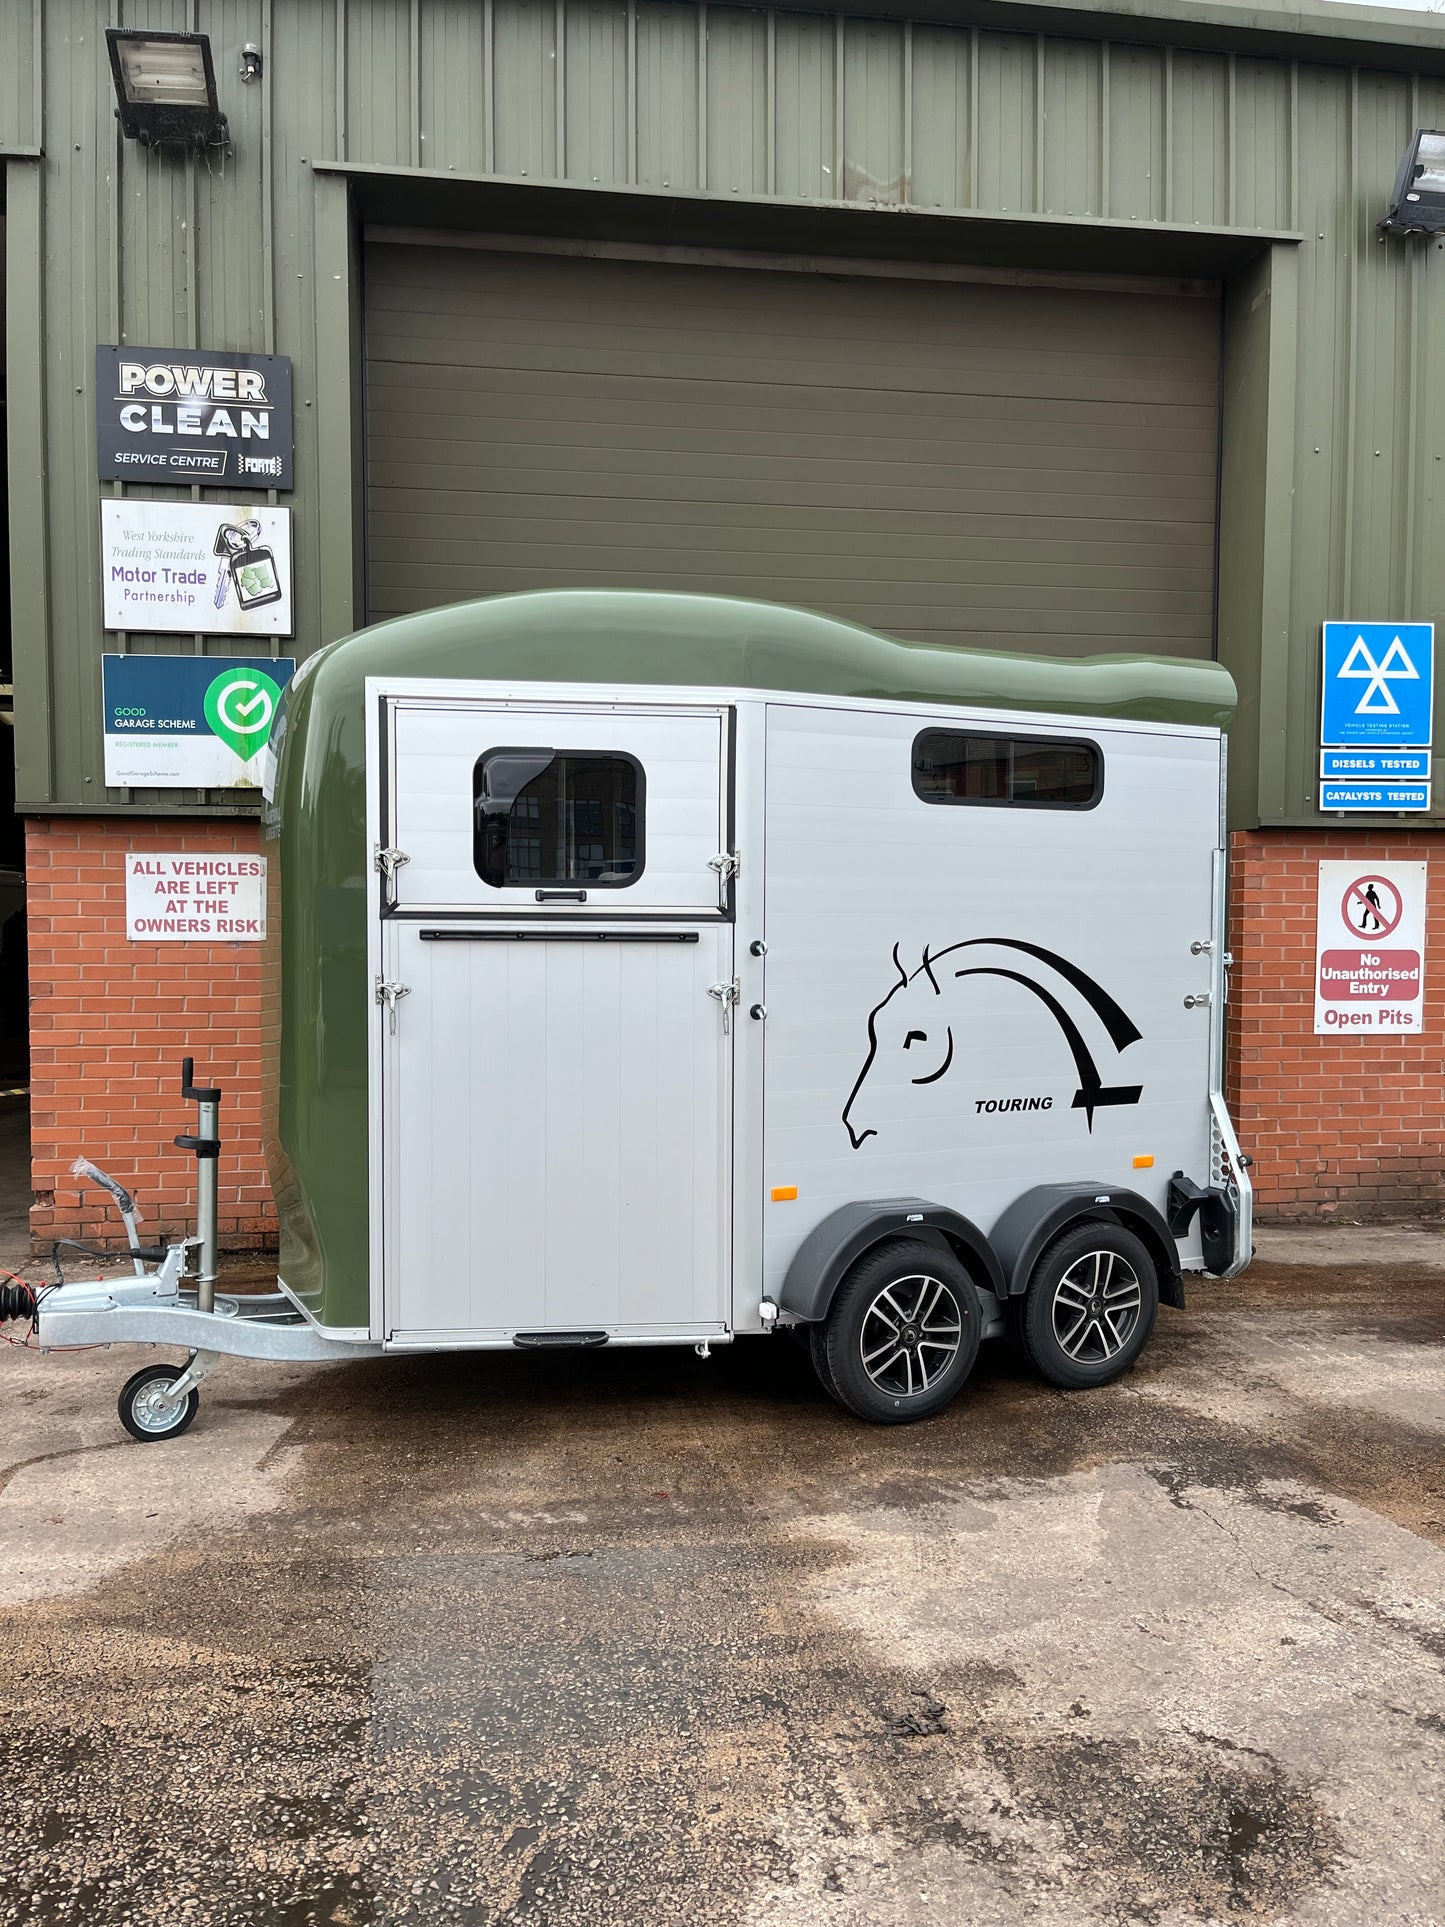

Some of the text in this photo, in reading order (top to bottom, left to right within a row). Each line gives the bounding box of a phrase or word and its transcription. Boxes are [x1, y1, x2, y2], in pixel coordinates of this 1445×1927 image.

[119, 362, 268, 403] POWER
[120, 404, 270, 440] CLEAN
[114, 452, 220, 468] SERVICE CENTRE
[123, 530, 194, 544] West Yorkshire
[112, 547, 206, 562] Trading Standards
[112, 566, 207, 585] Motor Trade
[124, 588, 195, 606] Partnership
[114, 708, 146, 716] GOOD
[114, 718, 196, 729] GARAGE SCHEME
[1332, 759, 1420, 769] DIESELS TESTED
[1326, 792, 1425, 801] CATALYSTS TESTED
[133, 861, 260, 876] ALL VEHICLES
[154, 880, 239, 895] ARE LEFT
[165, 900, 228, 914] AT THE
[134, 918, 258, 933] OWNERS RISK
[1360, 954, 1380, 966] No
[1322, 968, 1418, 980] Unauthorised
[1350, 982, 1390, 996] Entry
[1324, 1010, 1413, 1028] Open Pits
[975, 1096, 1053, 1114] TOURING
